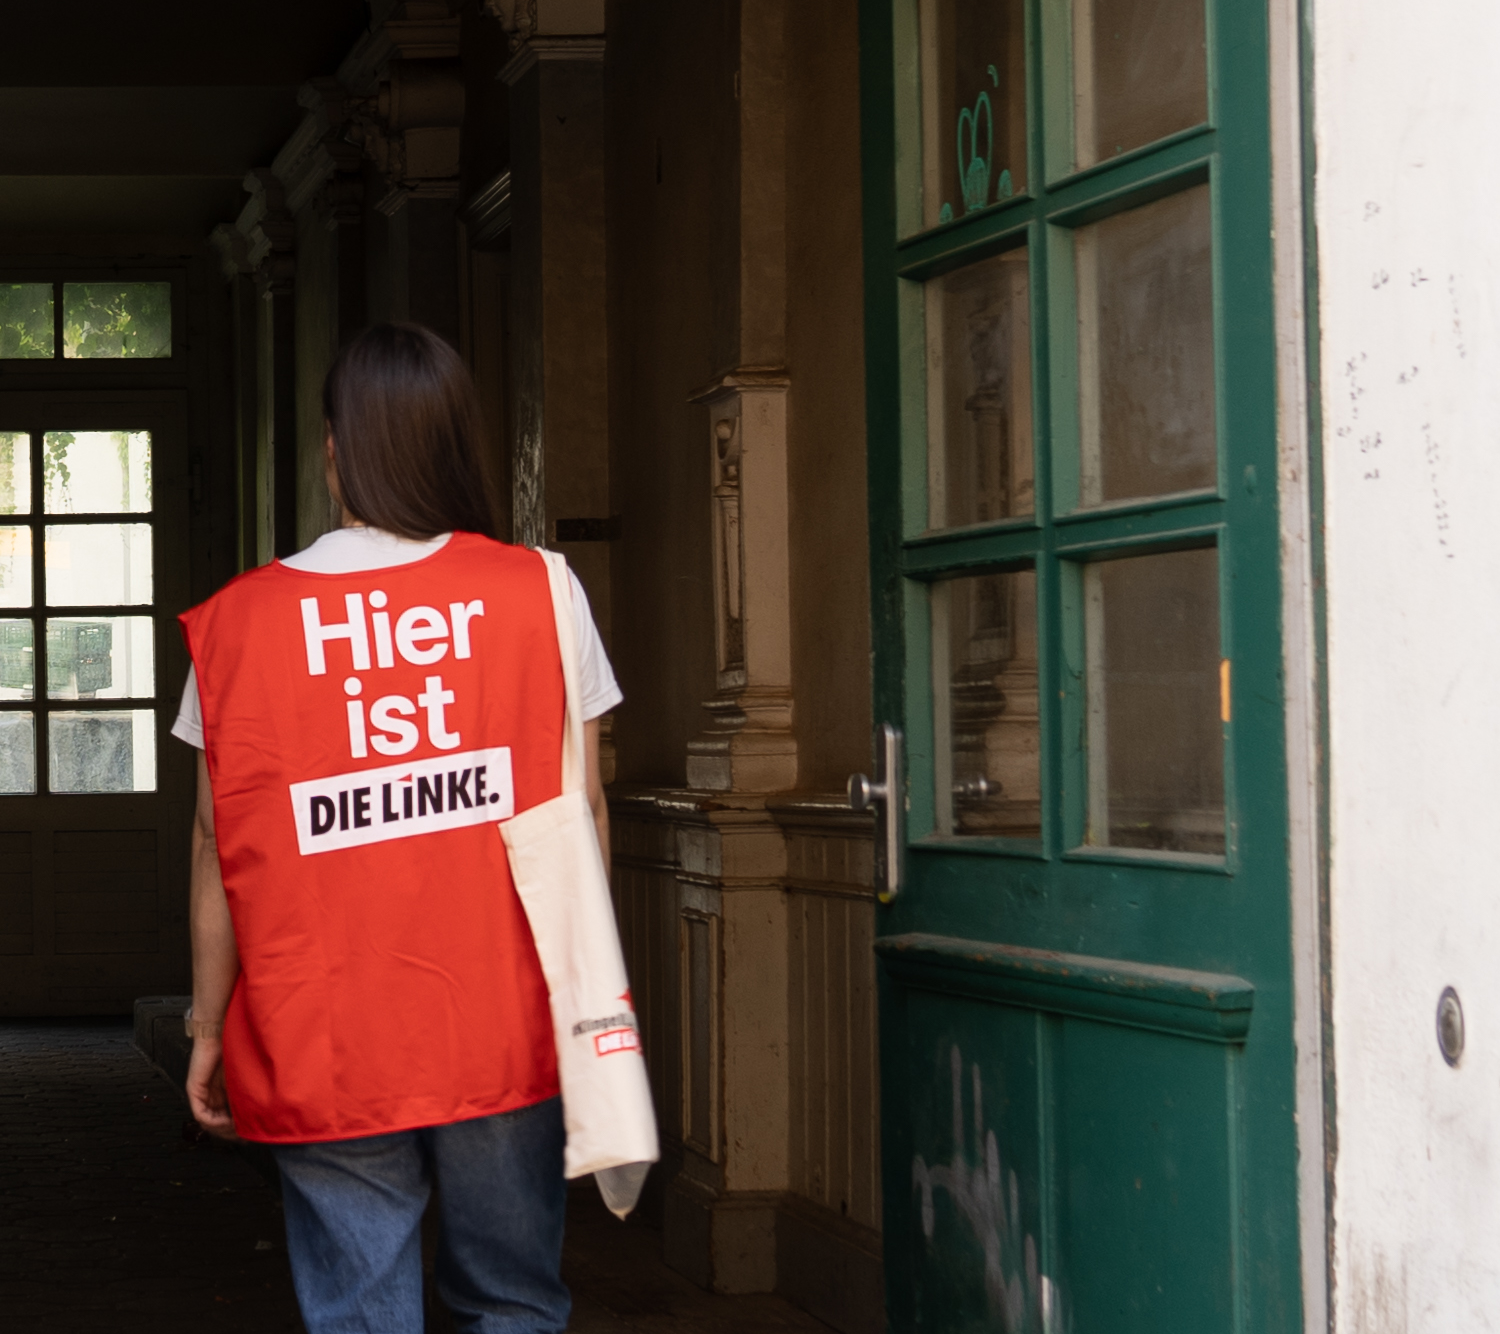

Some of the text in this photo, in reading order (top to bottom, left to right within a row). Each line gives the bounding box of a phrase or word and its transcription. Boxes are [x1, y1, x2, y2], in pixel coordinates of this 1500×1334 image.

[300, 589, 485, 676] Hier
[344, 675, 460, 759] ist
[309, 786, 371, 837] DIE
